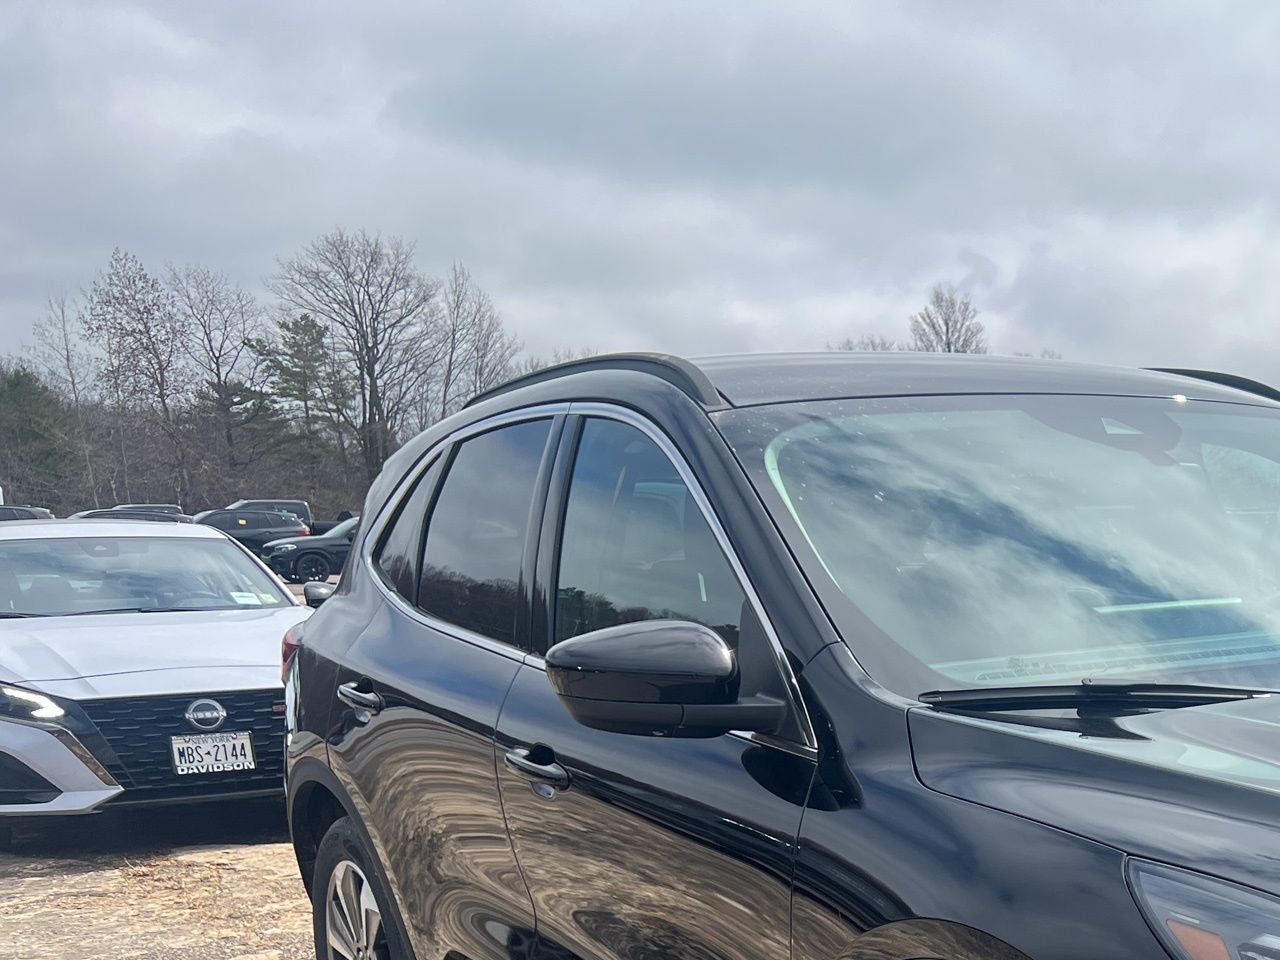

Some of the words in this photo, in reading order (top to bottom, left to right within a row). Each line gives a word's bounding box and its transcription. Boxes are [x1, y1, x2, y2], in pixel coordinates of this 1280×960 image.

[185, 710, 227, 720] NISSAN
[191, 737, 209, 745] NEW
[209, 735, 232, 743] YORK
[177, 761, 256, 775] DAVIDSON
